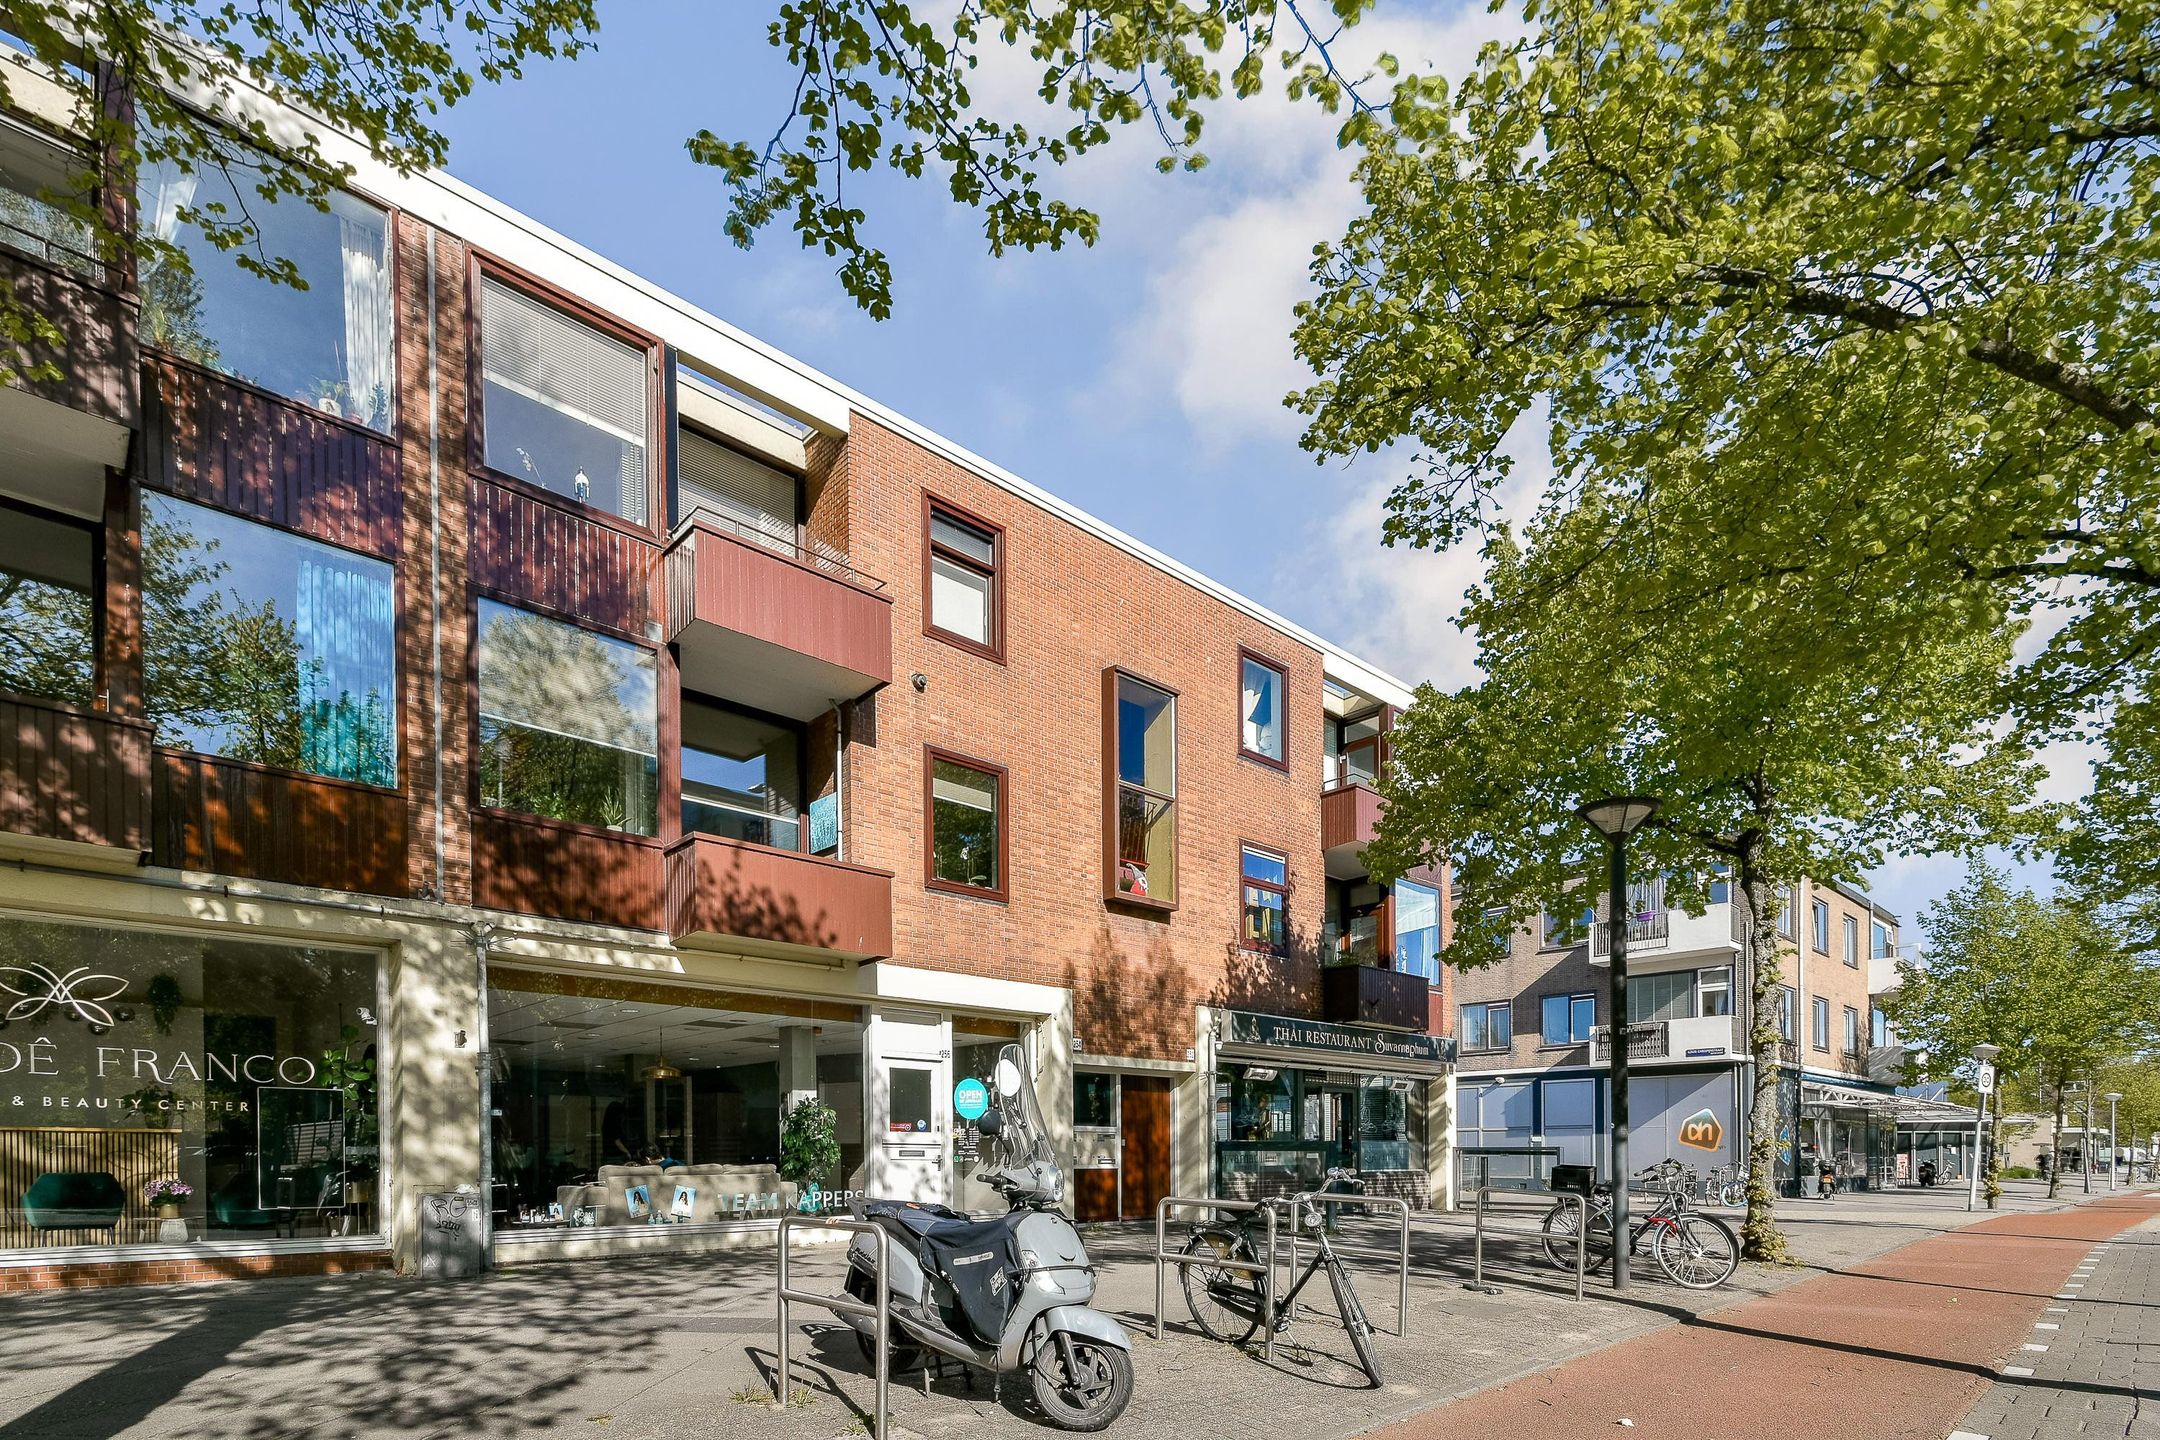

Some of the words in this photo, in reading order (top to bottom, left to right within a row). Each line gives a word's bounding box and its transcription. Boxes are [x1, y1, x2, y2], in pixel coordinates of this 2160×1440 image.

[1273, 1026, 1302, 1042] THAI
[1306, 1030, 1372, 1049] RESTAURANT
[96, 1046, 316, 1085] FRANCO
[12, 1095, 25, 1107] &
[42, 1096, 142, 1109] BEAUTY
[158, 1099, 249, 1112] CENTER
[959, 1090, 983, 1100] OPEN
[717, 1192, 778, 1212] TEAM
